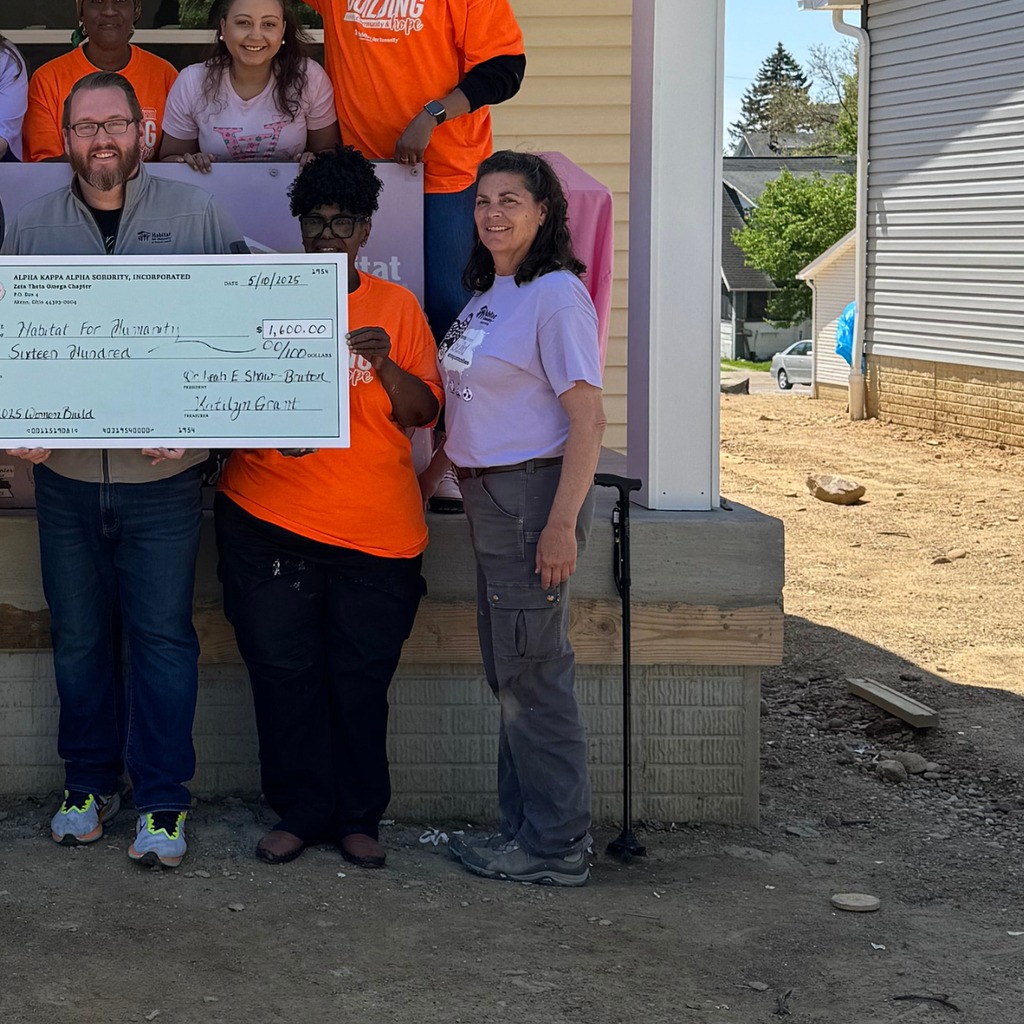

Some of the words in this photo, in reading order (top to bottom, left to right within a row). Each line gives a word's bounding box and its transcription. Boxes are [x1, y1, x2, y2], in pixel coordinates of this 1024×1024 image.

[389, 14, 424, 36] hope
[133, 273, 191, 281] INCORPORATED
[248, 271, 301, 290] 5/10/2025
[17, 320, 69, 338] Habitat
[80, 320, 102, 337] For
[268, 323, 327, 338] 1,600.00
[8, 343, 58, 360] Sixteen
[67, 343, 131, 360] Hundred
